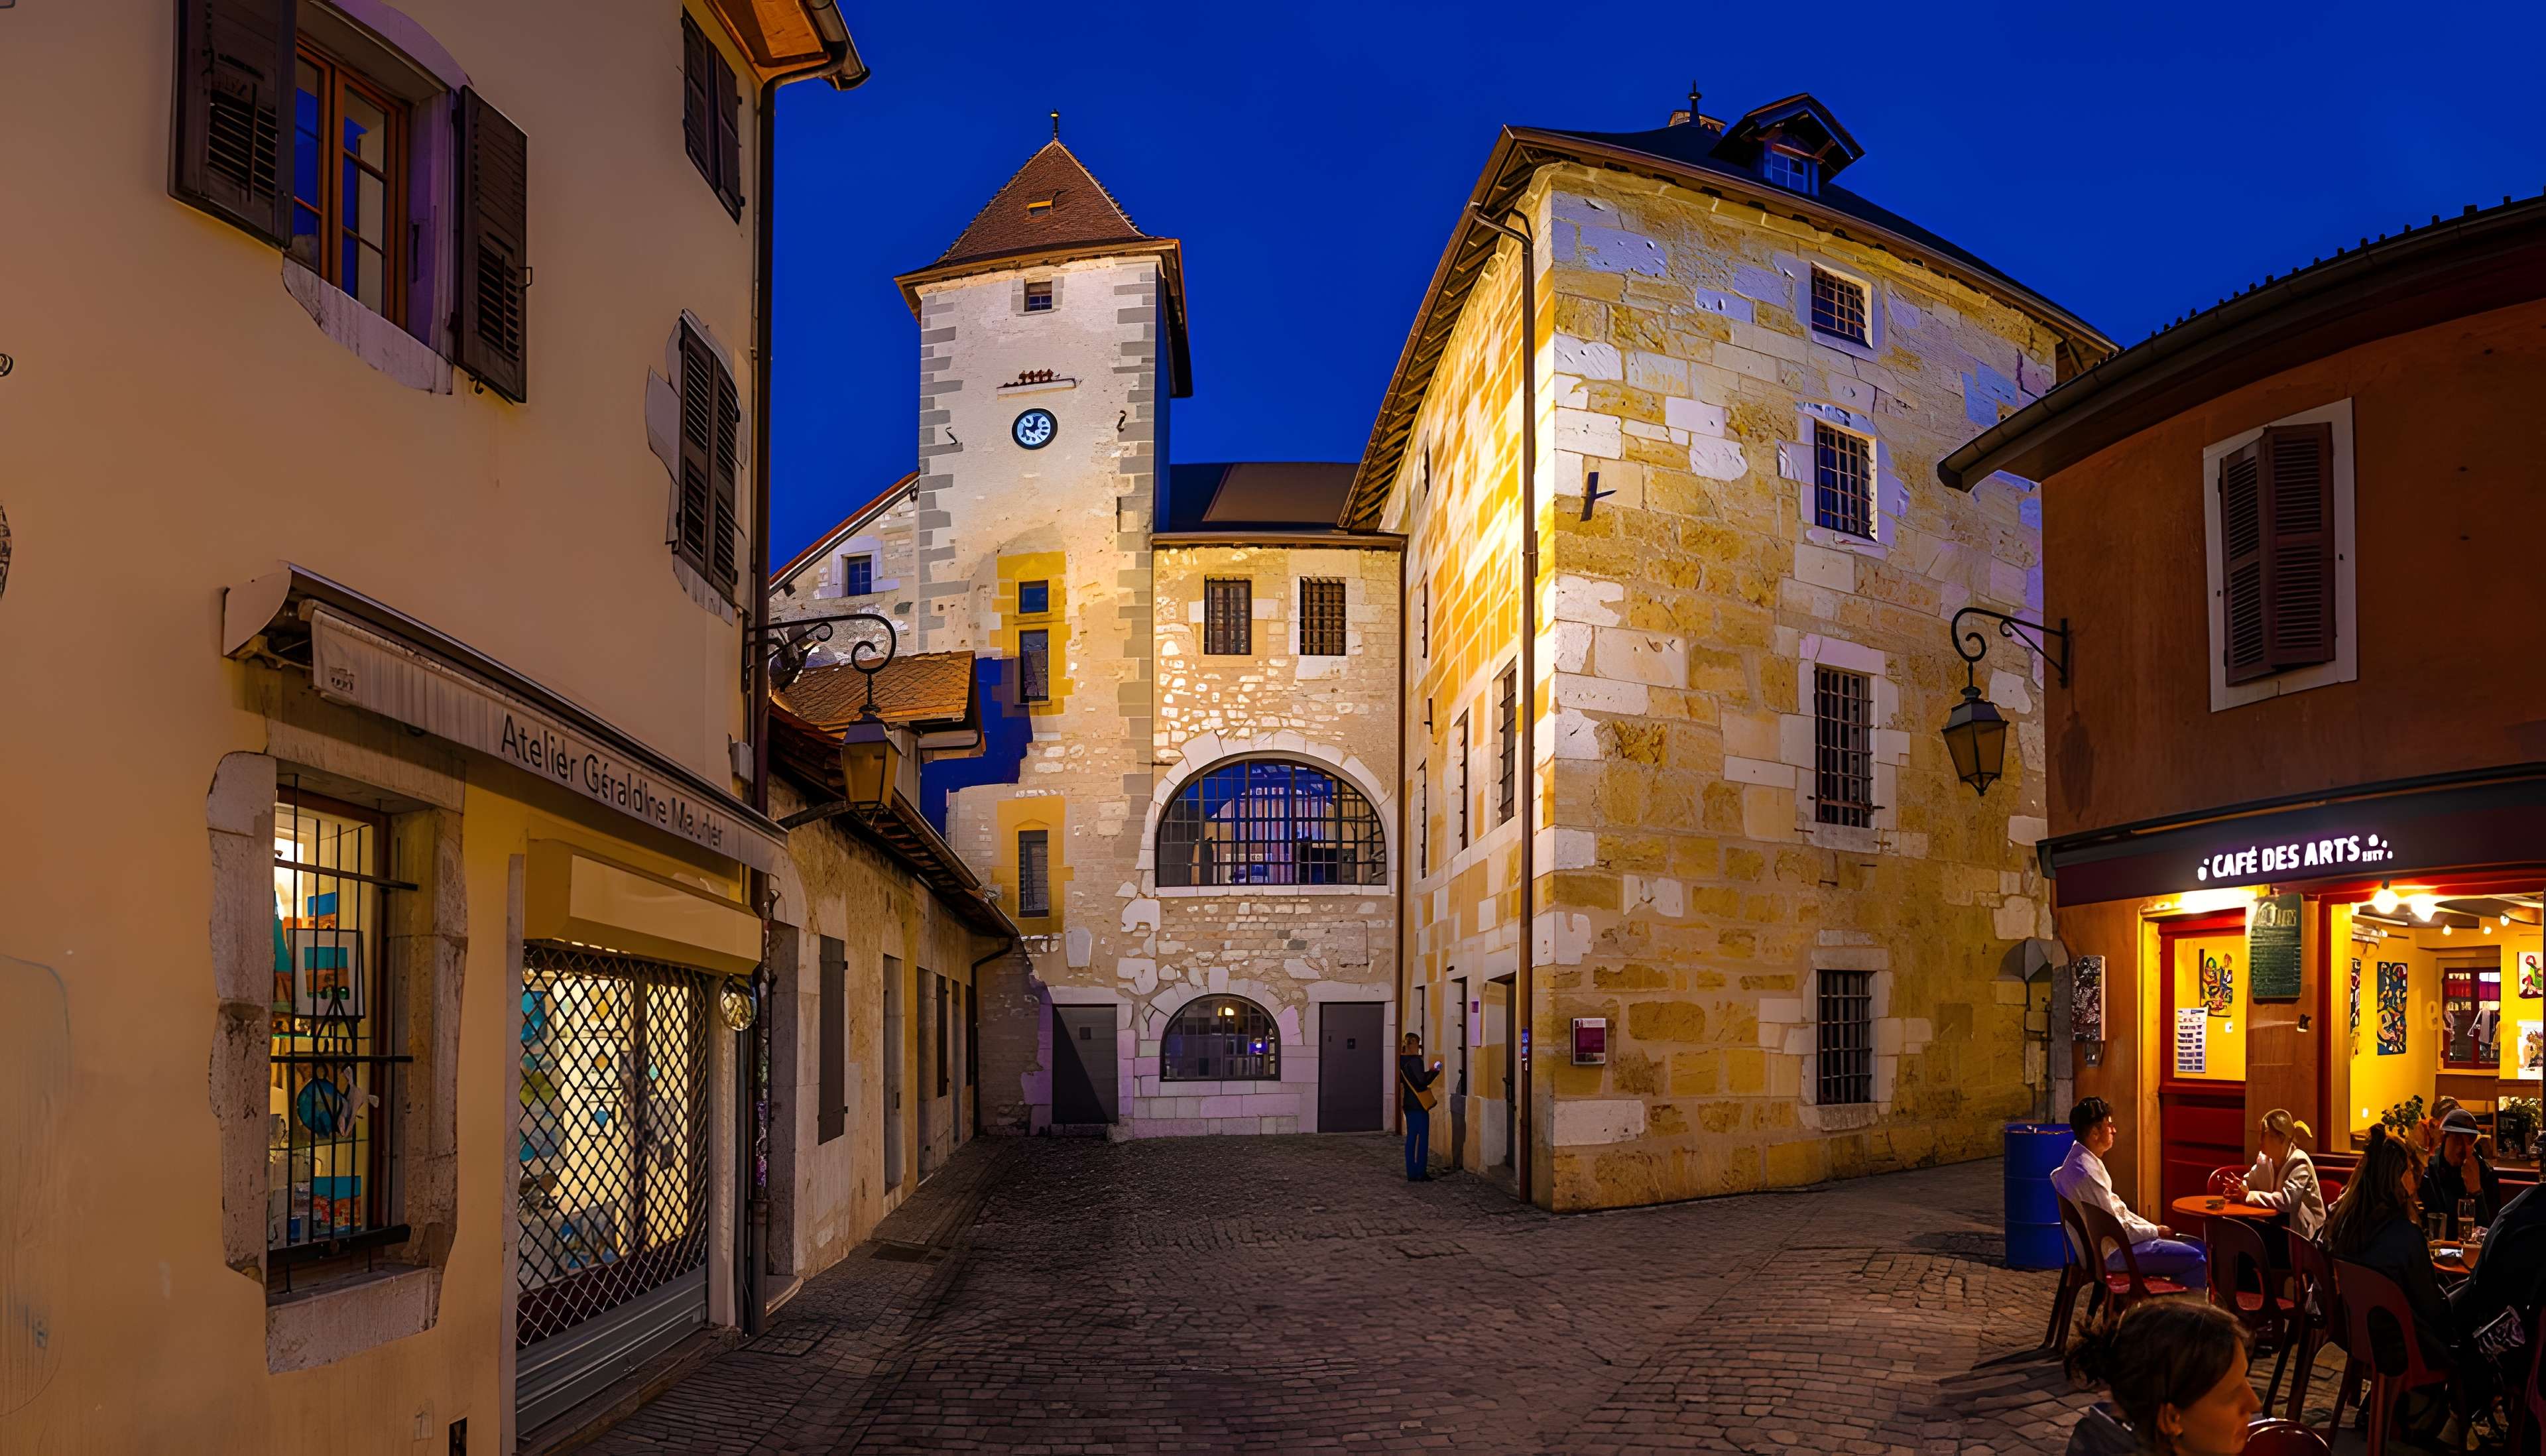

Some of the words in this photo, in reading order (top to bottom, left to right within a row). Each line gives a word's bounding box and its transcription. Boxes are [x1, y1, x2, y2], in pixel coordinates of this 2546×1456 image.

[501, 714, 577, 782] Atelier
[583, 753, 667, 823] Géraldine
[2212, 846, 2258, 878] CAFÉ
[2262, 844, 2299, 872] DES
[2304, 835, 2360, 867] ARTS
